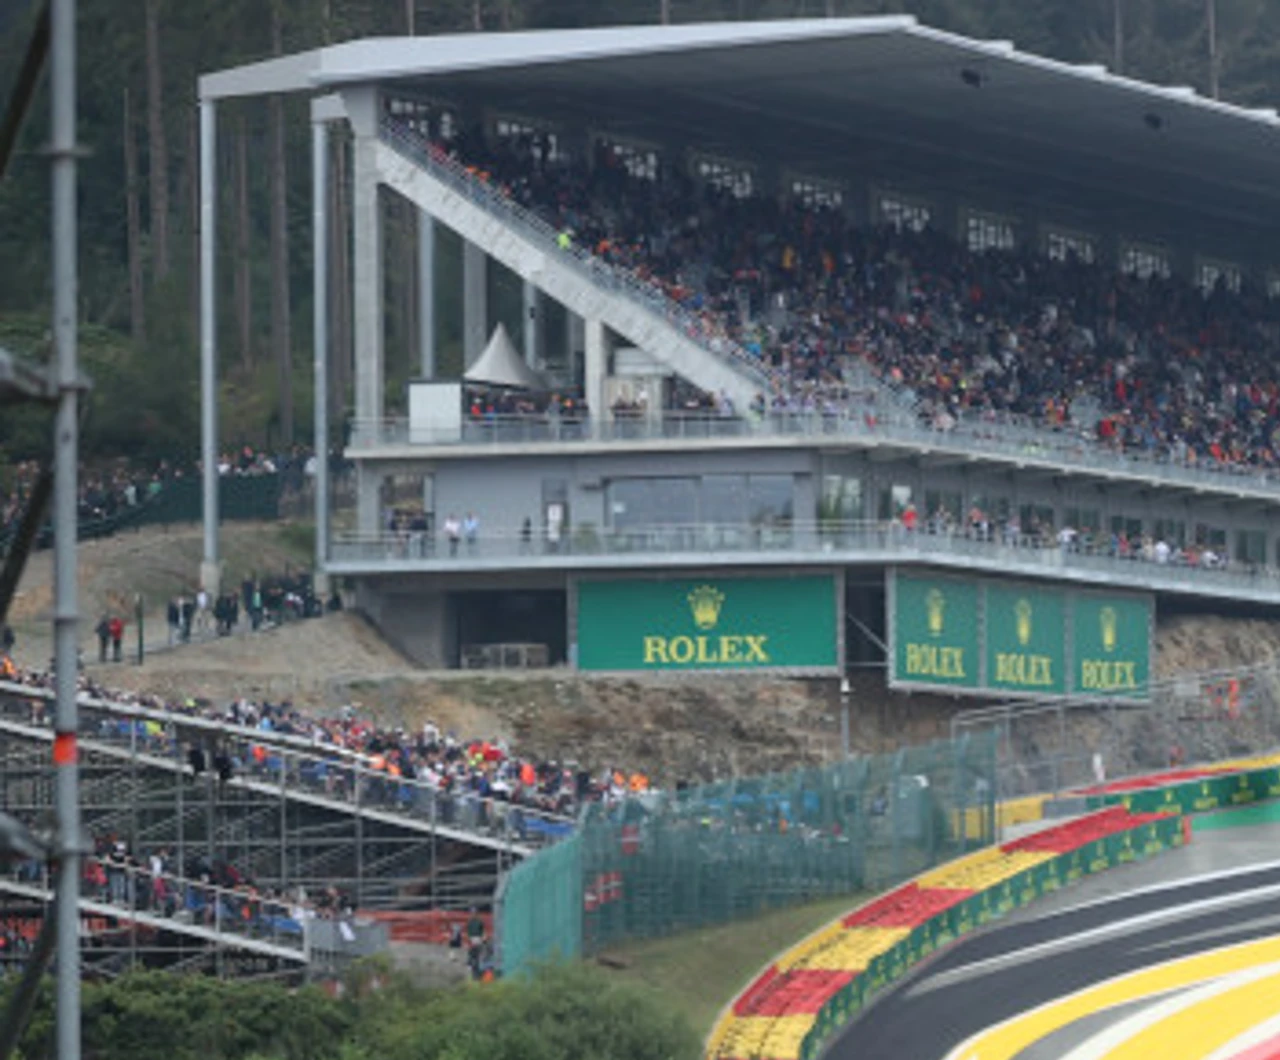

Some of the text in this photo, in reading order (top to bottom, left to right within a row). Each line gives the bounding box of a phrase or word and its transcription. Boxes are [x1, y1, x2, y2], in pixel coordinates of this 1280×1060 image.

[643, 635, 769, 663] ROLEX
[906, 643, 966, 677] ROLEX
[996, 653, 1052, 685] ROLEX
[1082, 660, 1136, 689] ROLEX
